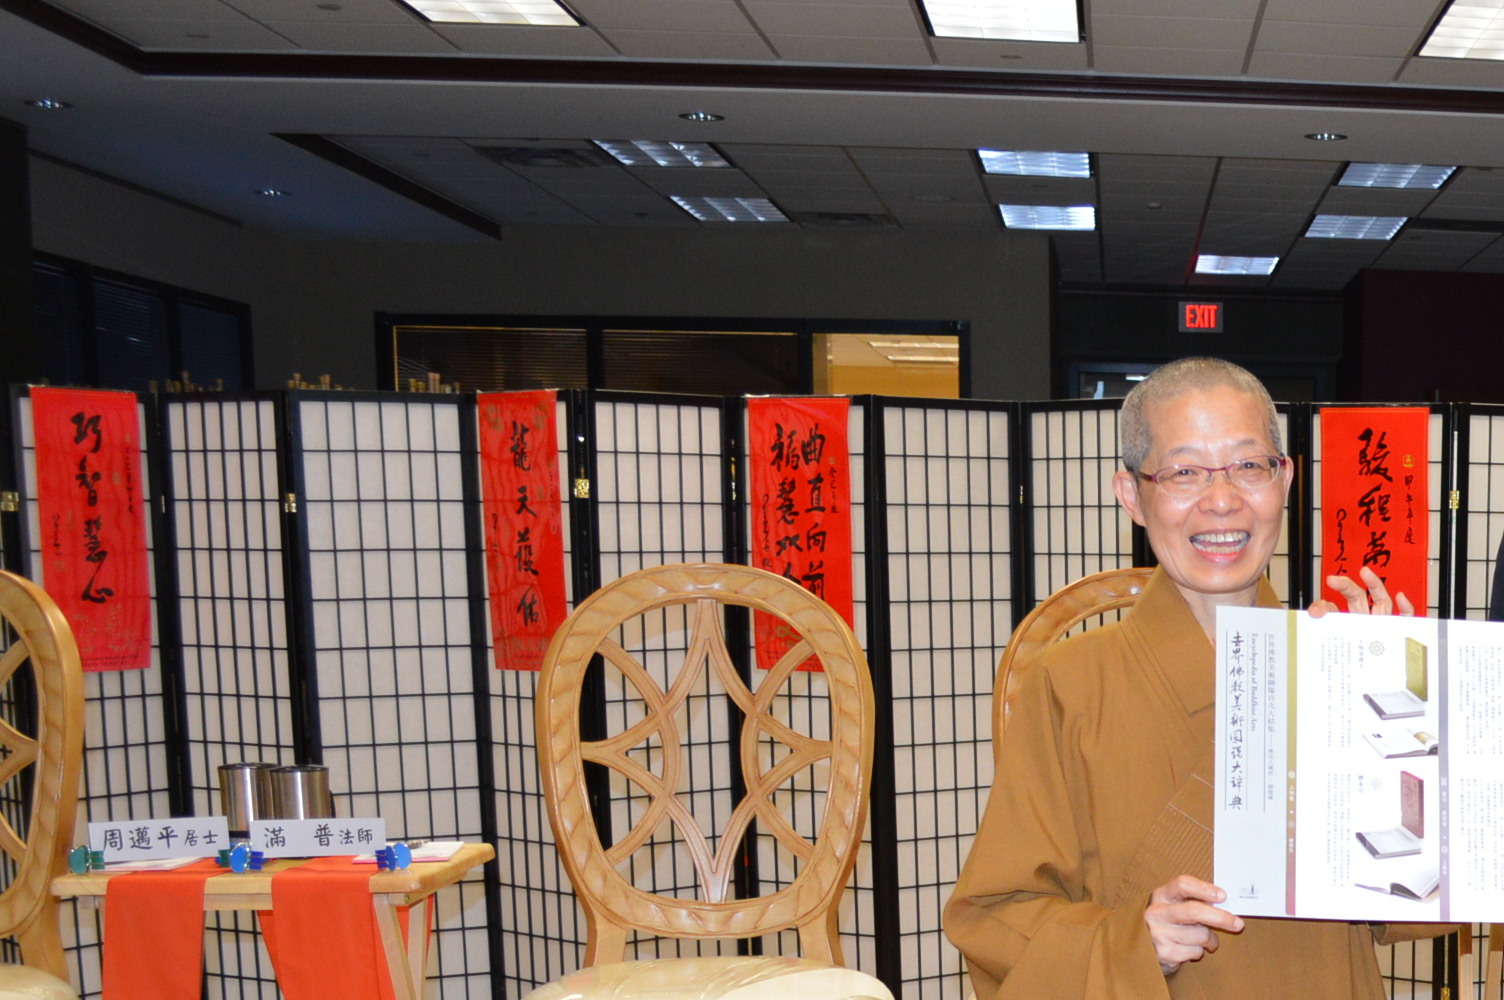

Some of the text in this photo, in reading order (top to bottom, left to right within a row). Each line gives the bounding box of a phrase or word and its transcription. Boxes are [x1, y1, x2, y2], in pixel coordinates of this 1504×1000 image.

[1185, 304, 1218, 328] EXIT
[1357, 427, 1393, 610] 駿程萬
[1249, 633, 1258, 675] Encyclopedia
[1250, 686, 1258, 716] Buddhist
[1250, 717, 1258, 732] Arts
[103, 826, 218, 851] 周邁平居士
